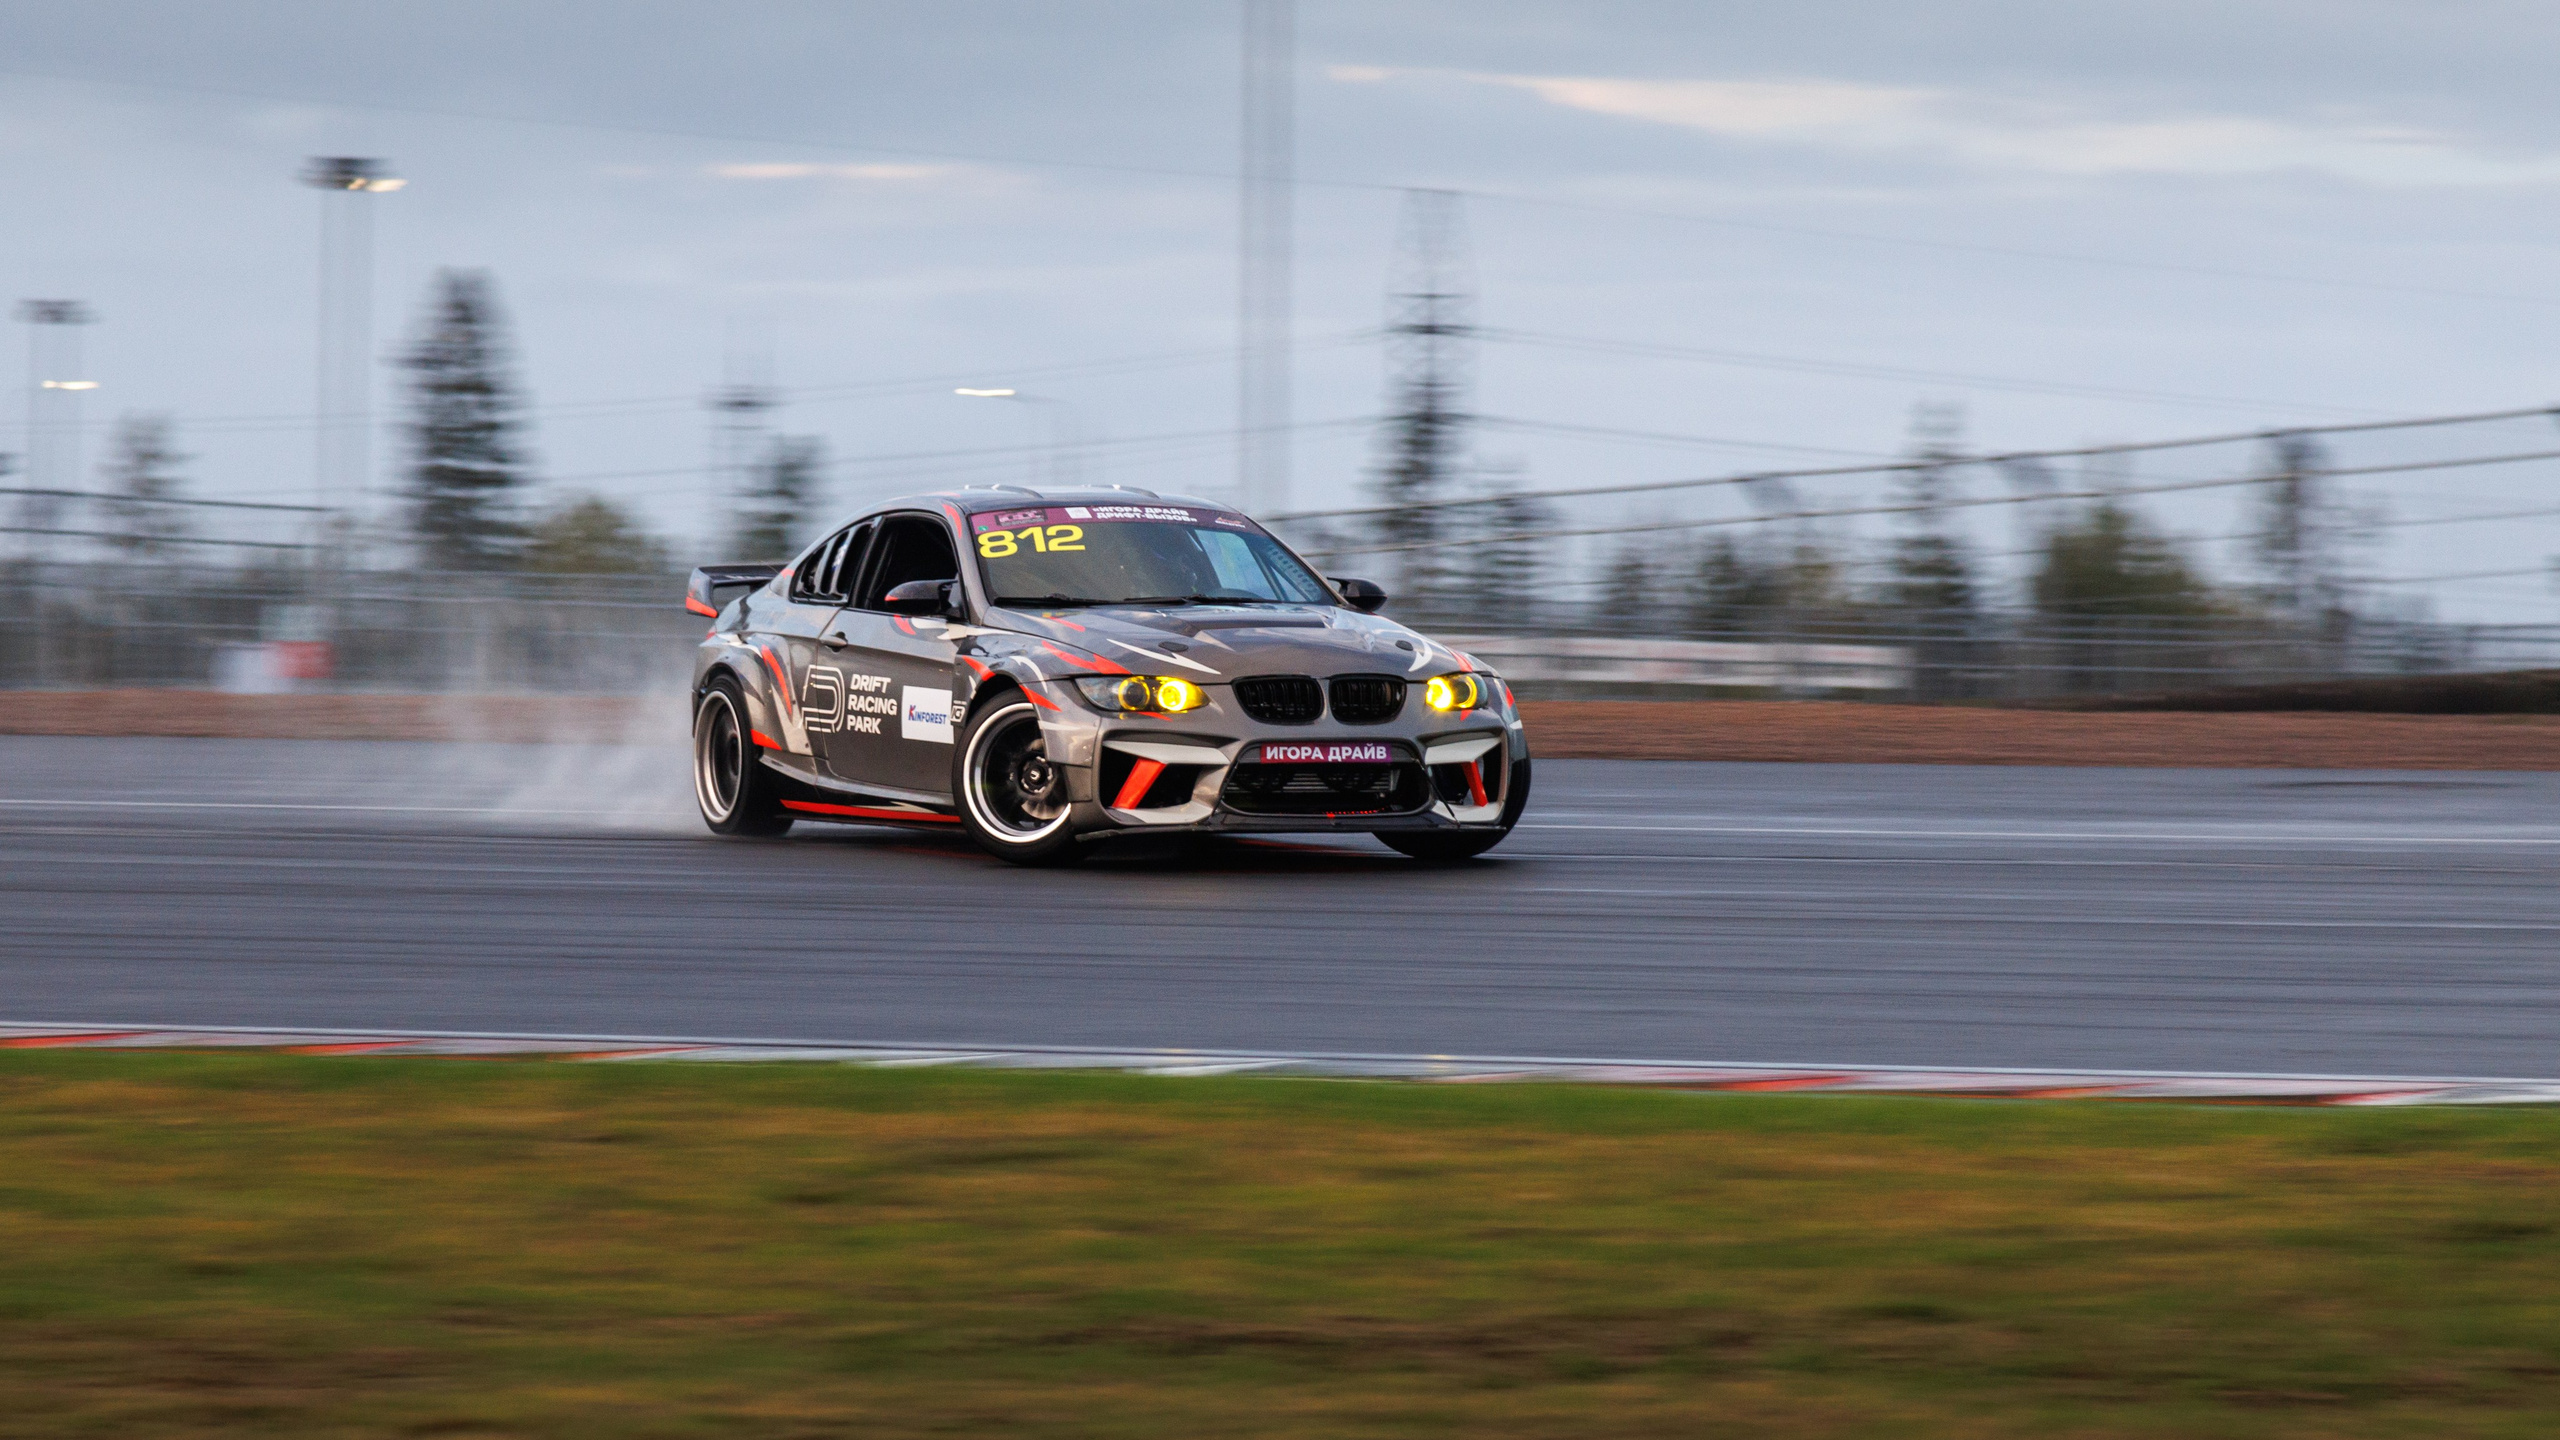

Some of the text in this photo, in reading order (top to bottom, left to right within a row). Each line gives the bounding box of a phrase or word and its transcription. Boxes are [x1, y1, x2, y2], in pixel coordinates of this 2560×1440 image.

[1096, 512, 1198, 523] ДРИФТ-ВЫЗОВ»
[1144, 507, 1190, 516] ДРАЙВ
[978, 525, 1086, 558] 812
[850, 674, 892, 693] DRIFT
[848, 694, 898, 716] RACING
[908, 704, 947, 724] KINFOREST
[847, 714, 882, 734] PARK
[1266, 743, 1387, 762] ИГОРА ДРАЙВ
